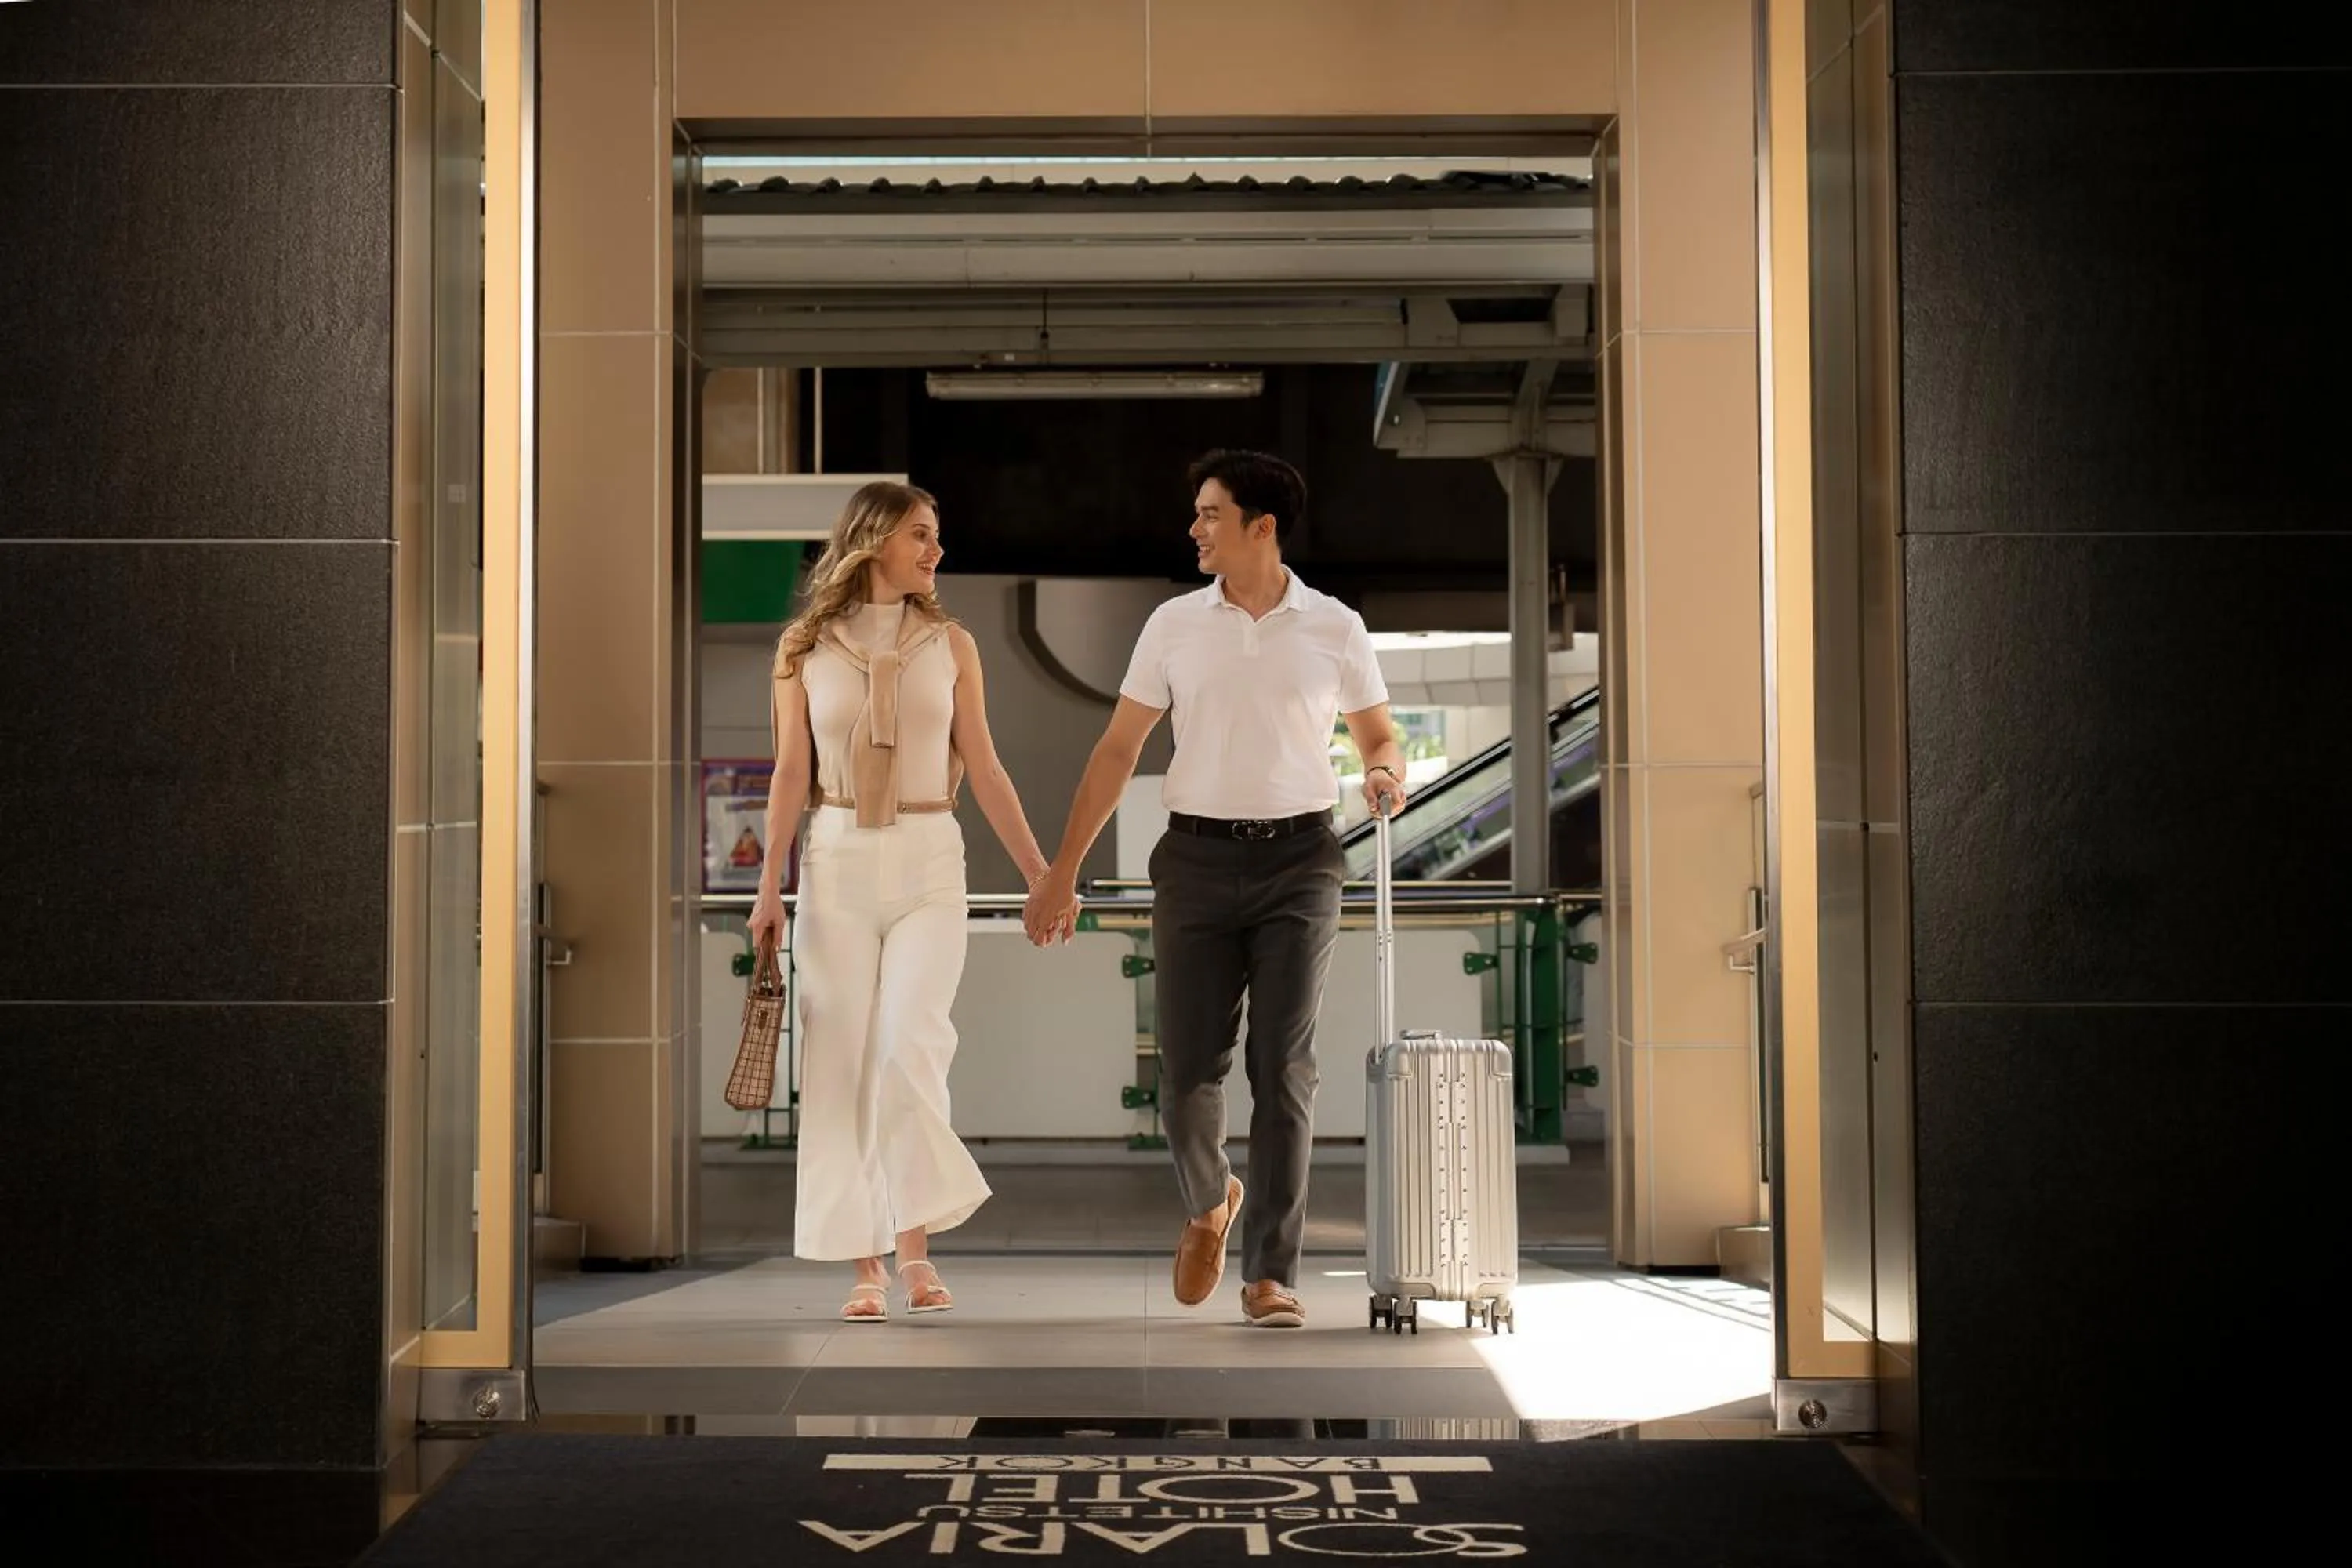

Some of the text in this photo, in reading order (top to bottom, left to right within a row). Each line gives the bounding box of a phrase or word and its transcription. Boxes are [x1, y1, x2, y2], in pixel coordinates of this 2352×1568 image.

[939, 1456, 1381, 1470] BANGKOK
[904, 1474, 1420, 1504] HOTEL
[917, 1505, 1398, 1519] NISHITETSU
[797, 1521, 1528, 1557] SOLARIA
